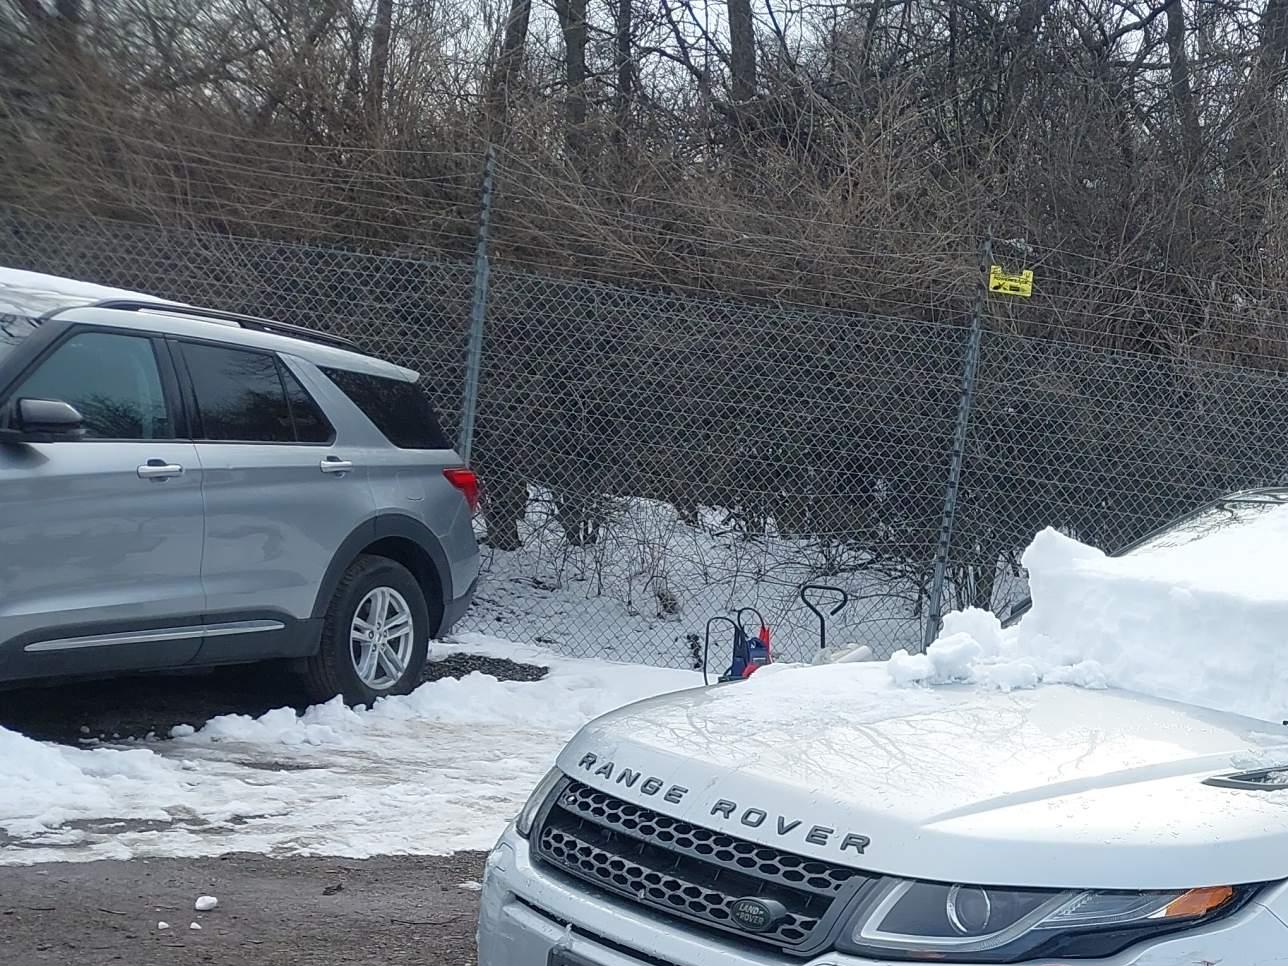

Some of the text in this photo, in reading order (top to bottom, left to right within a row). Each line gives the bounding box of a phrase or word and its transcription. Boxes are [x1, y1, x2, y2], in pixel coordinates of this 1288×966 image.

[578, 752, 870, 854] RANGE ROVER
[739, 903, 760, 915] LAND
[739, 912, 765, 925] ROVER
